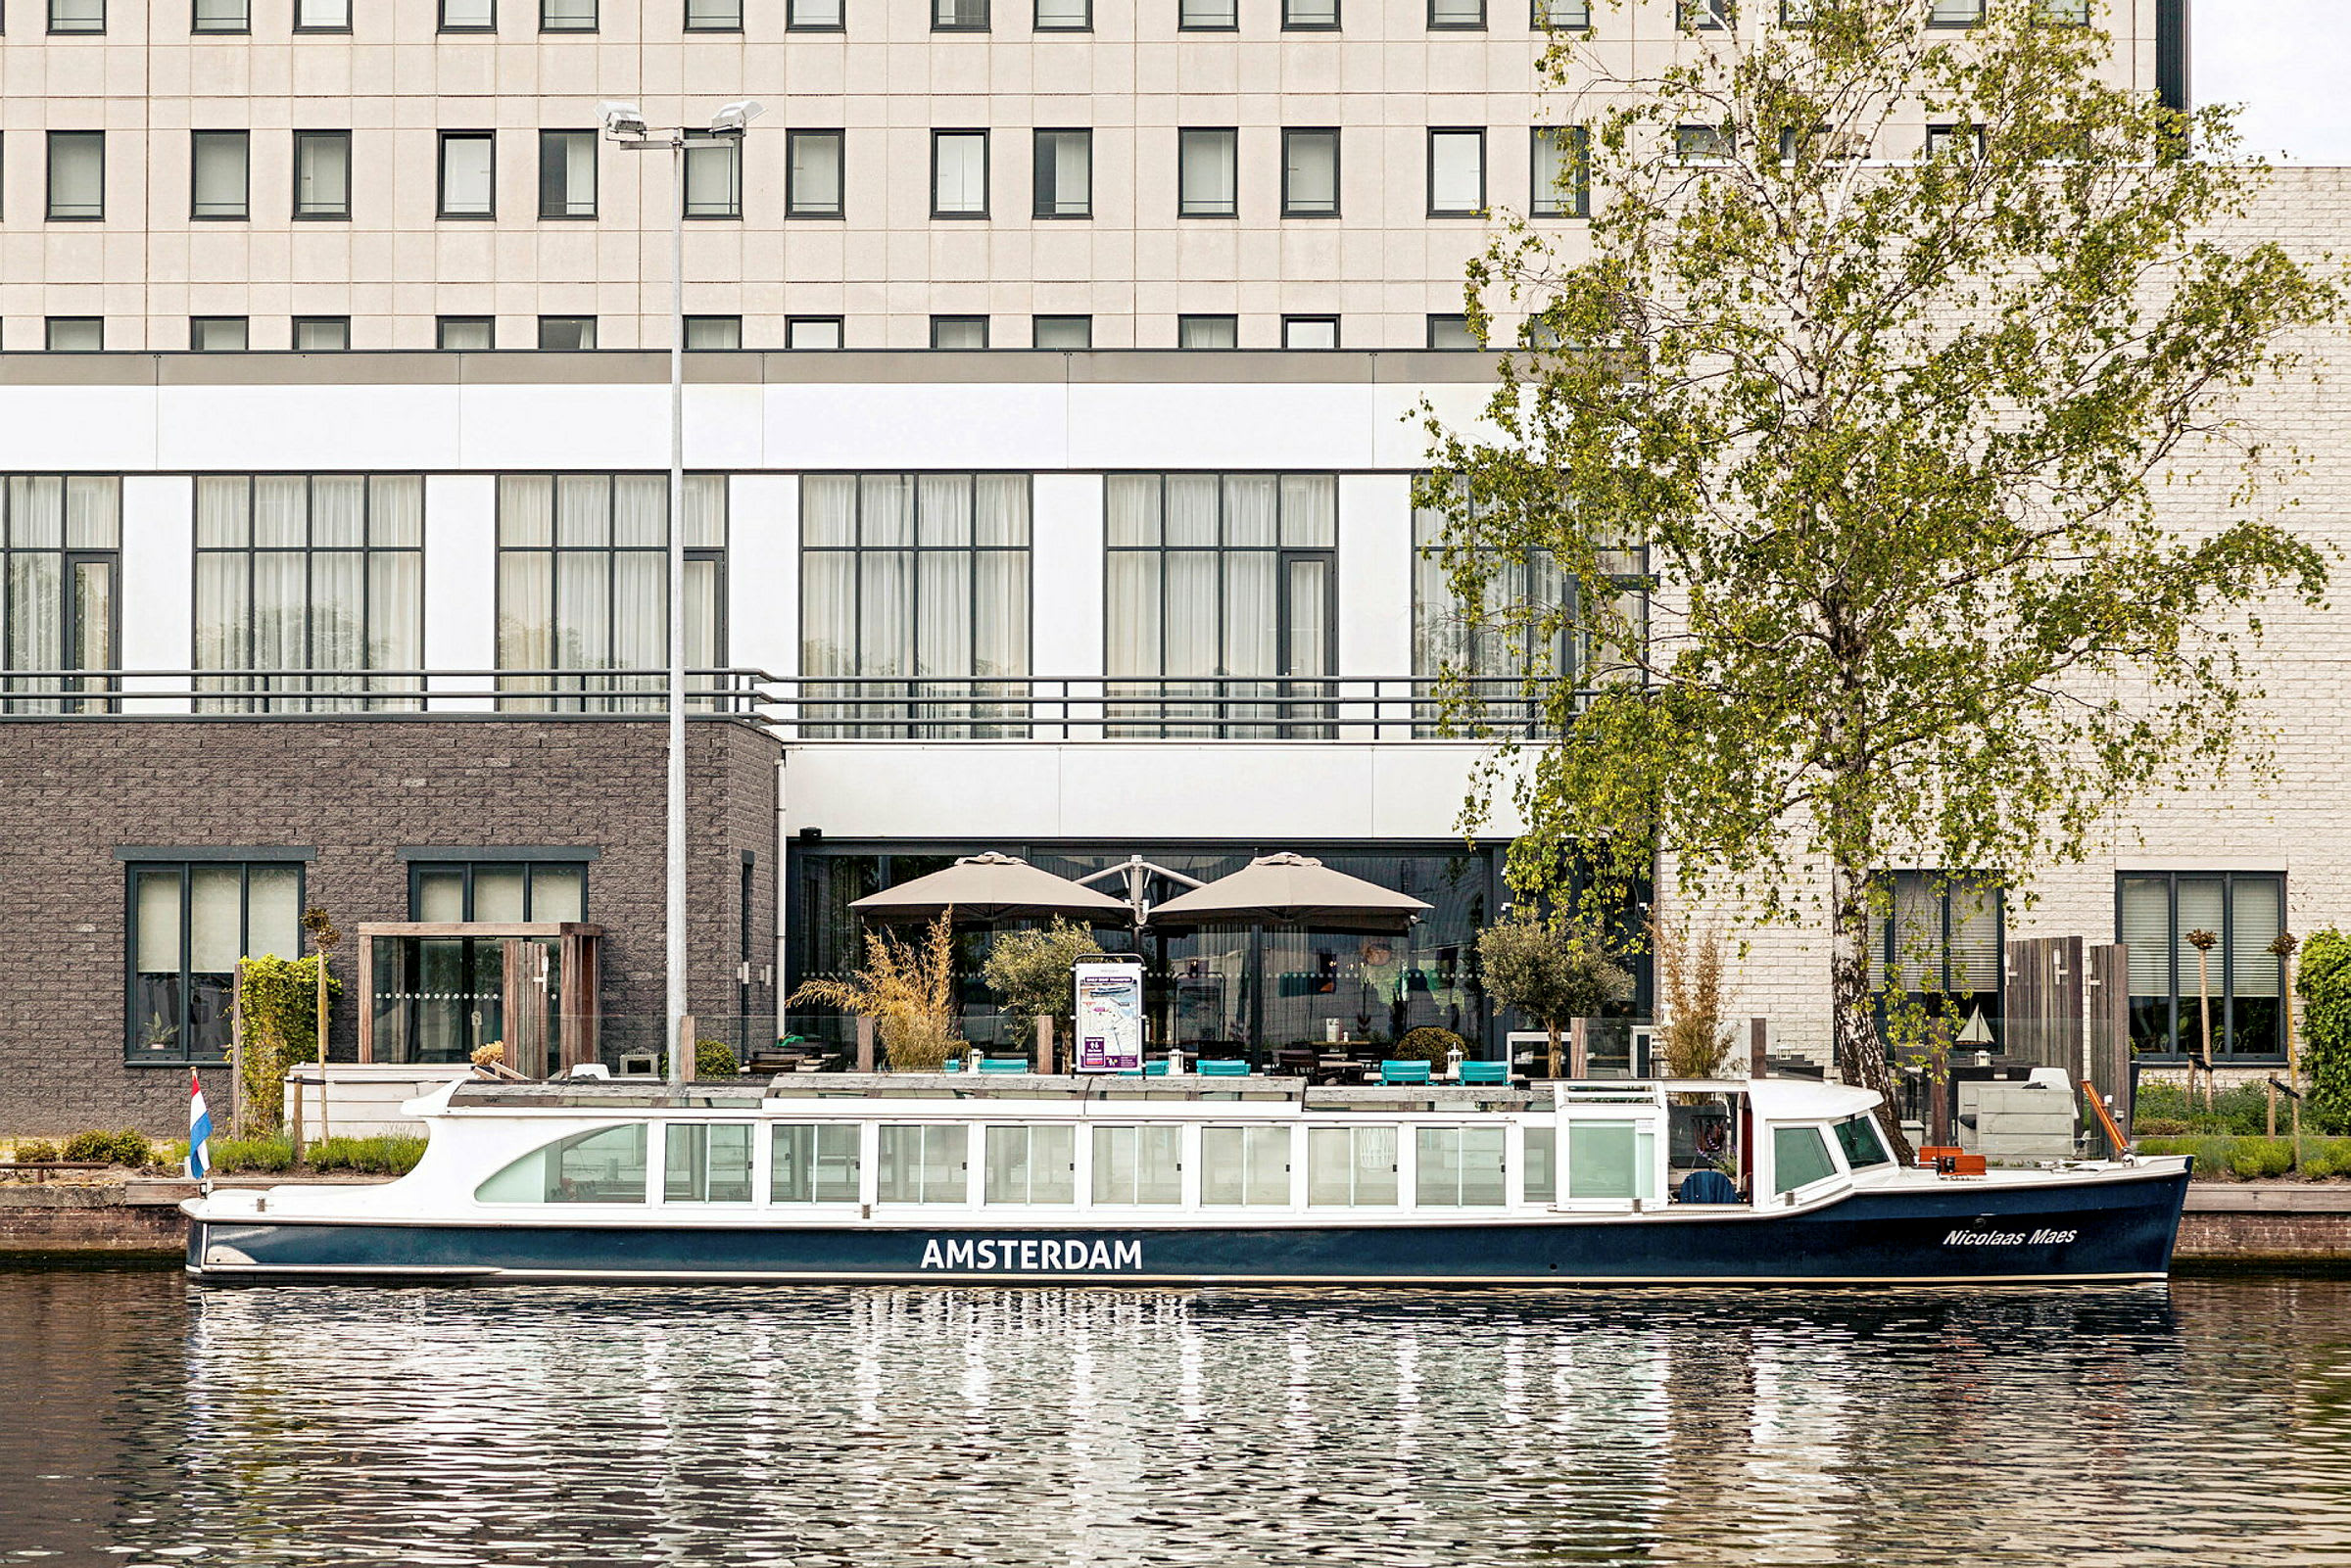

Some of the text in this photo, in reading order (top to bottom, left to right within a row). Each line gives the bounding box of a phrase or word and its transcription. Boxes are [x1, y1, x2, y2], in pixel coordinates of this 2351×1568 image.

[1943, 1228, 2078, 1246] Nicolaas Maes
[920, 1239, 1142, 1270] AMSTERDAM
